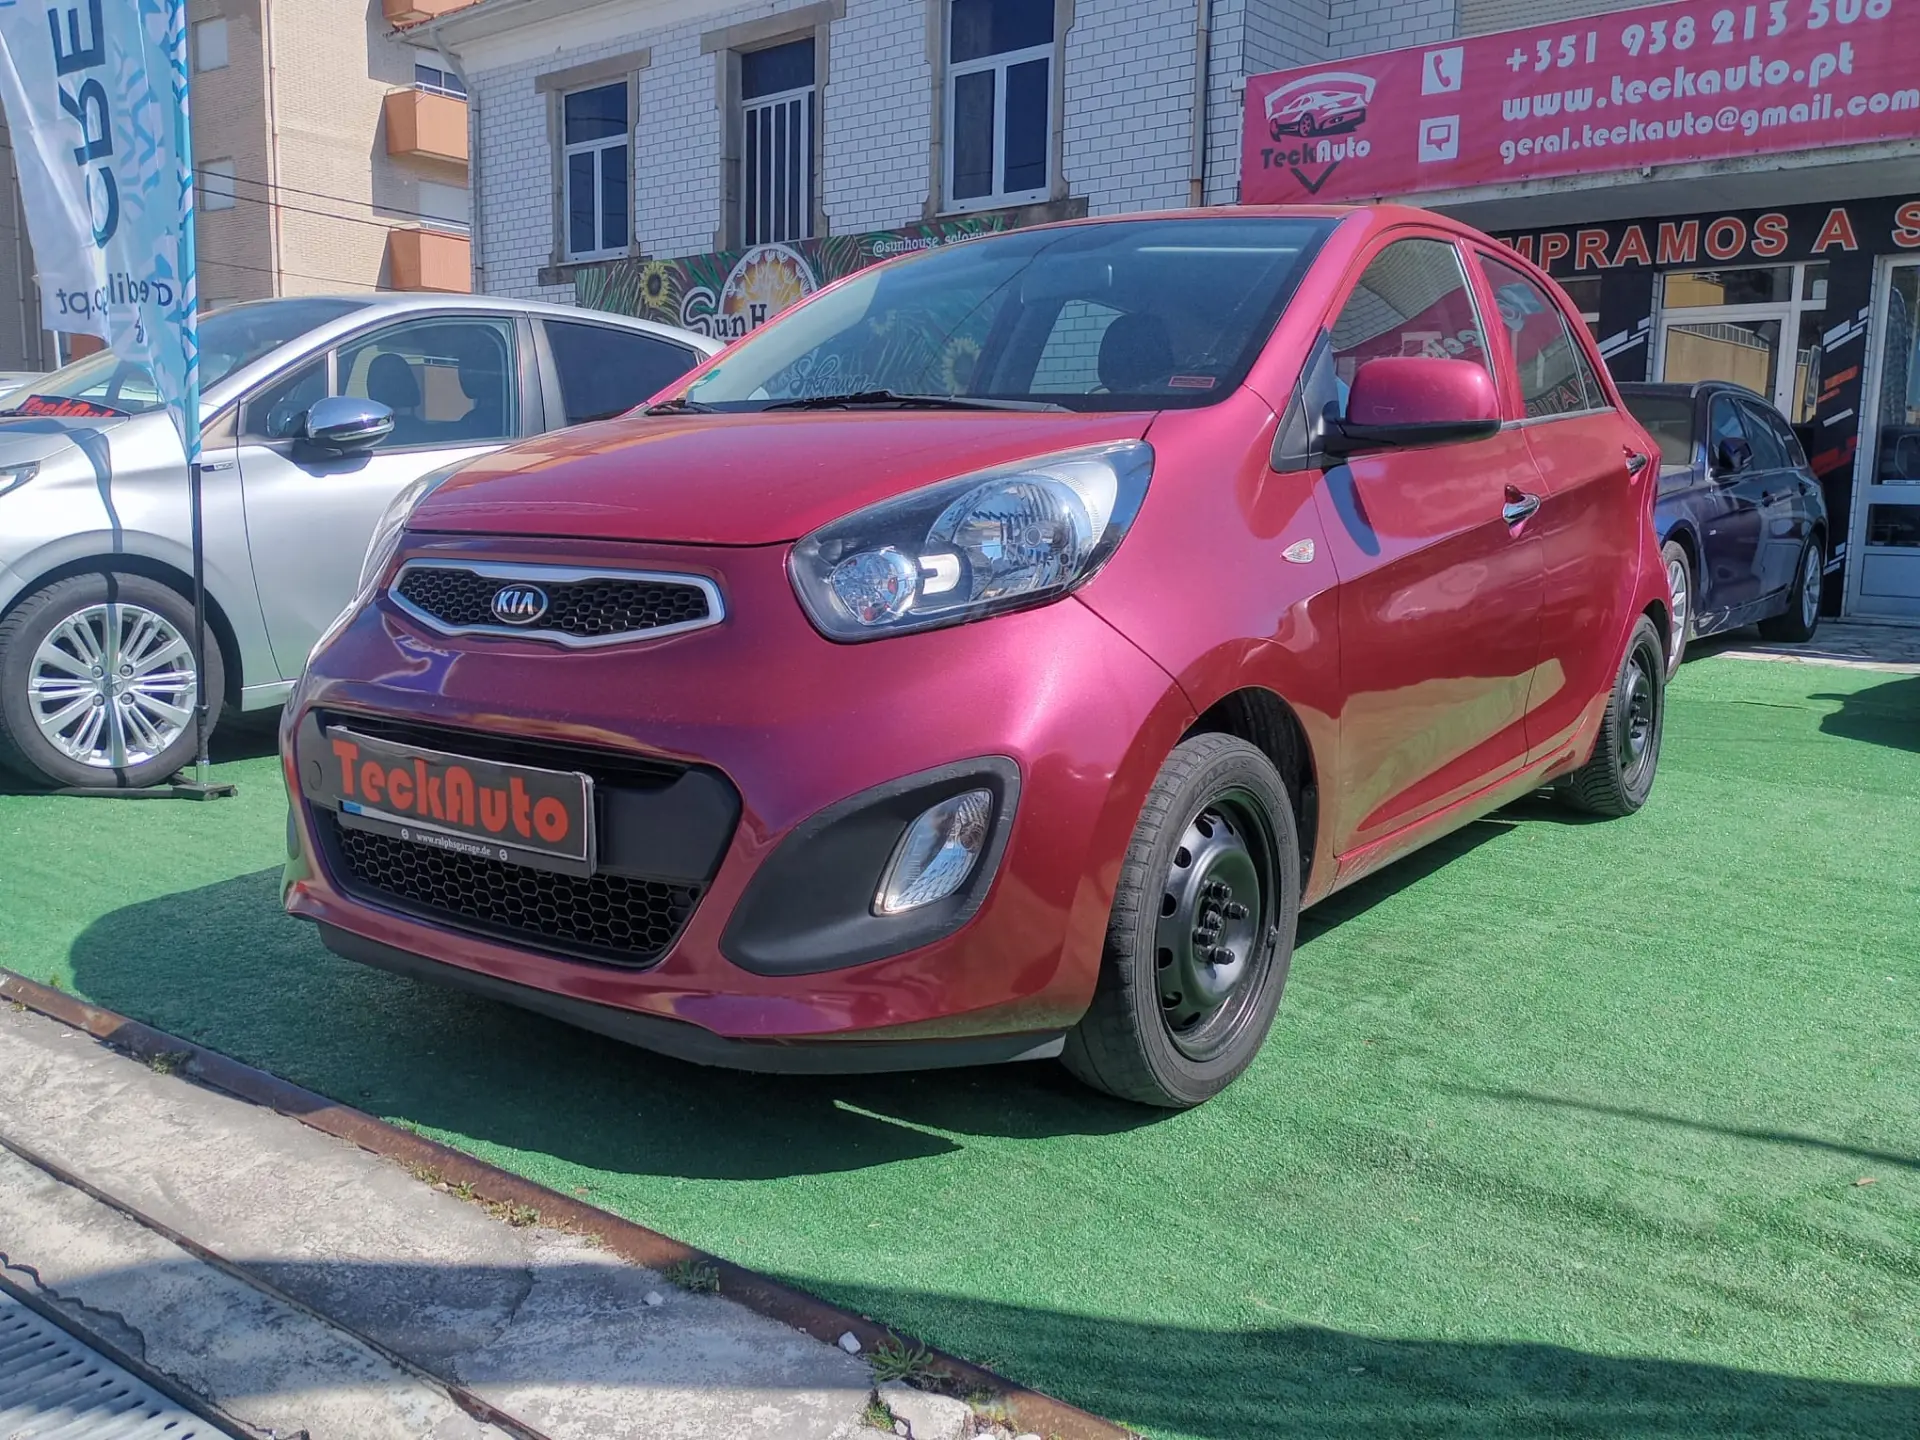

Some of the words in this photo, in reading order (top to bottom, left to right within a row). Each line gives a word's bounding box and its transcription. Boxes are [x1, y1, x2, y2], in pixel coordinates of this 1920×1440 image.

[1621, 15, 1696, 56] 938
[1711, 0, 1789, 45] 213
[1502, 41, 1854, 122] www.teckauto.pt
[1260, 136, 1371, 169] TeckAuto
[1500, 88, 1920, 165] geral.teckauto@gmail.com
[1810, 207, 1859, 254] A
[680, 286, 778, 339] SunH
[496, 590, 534, 615] KIA
[332, 739, 569, 842] TeckAuto
[415, 833, 492, 857] www.ralphsgarage.de
